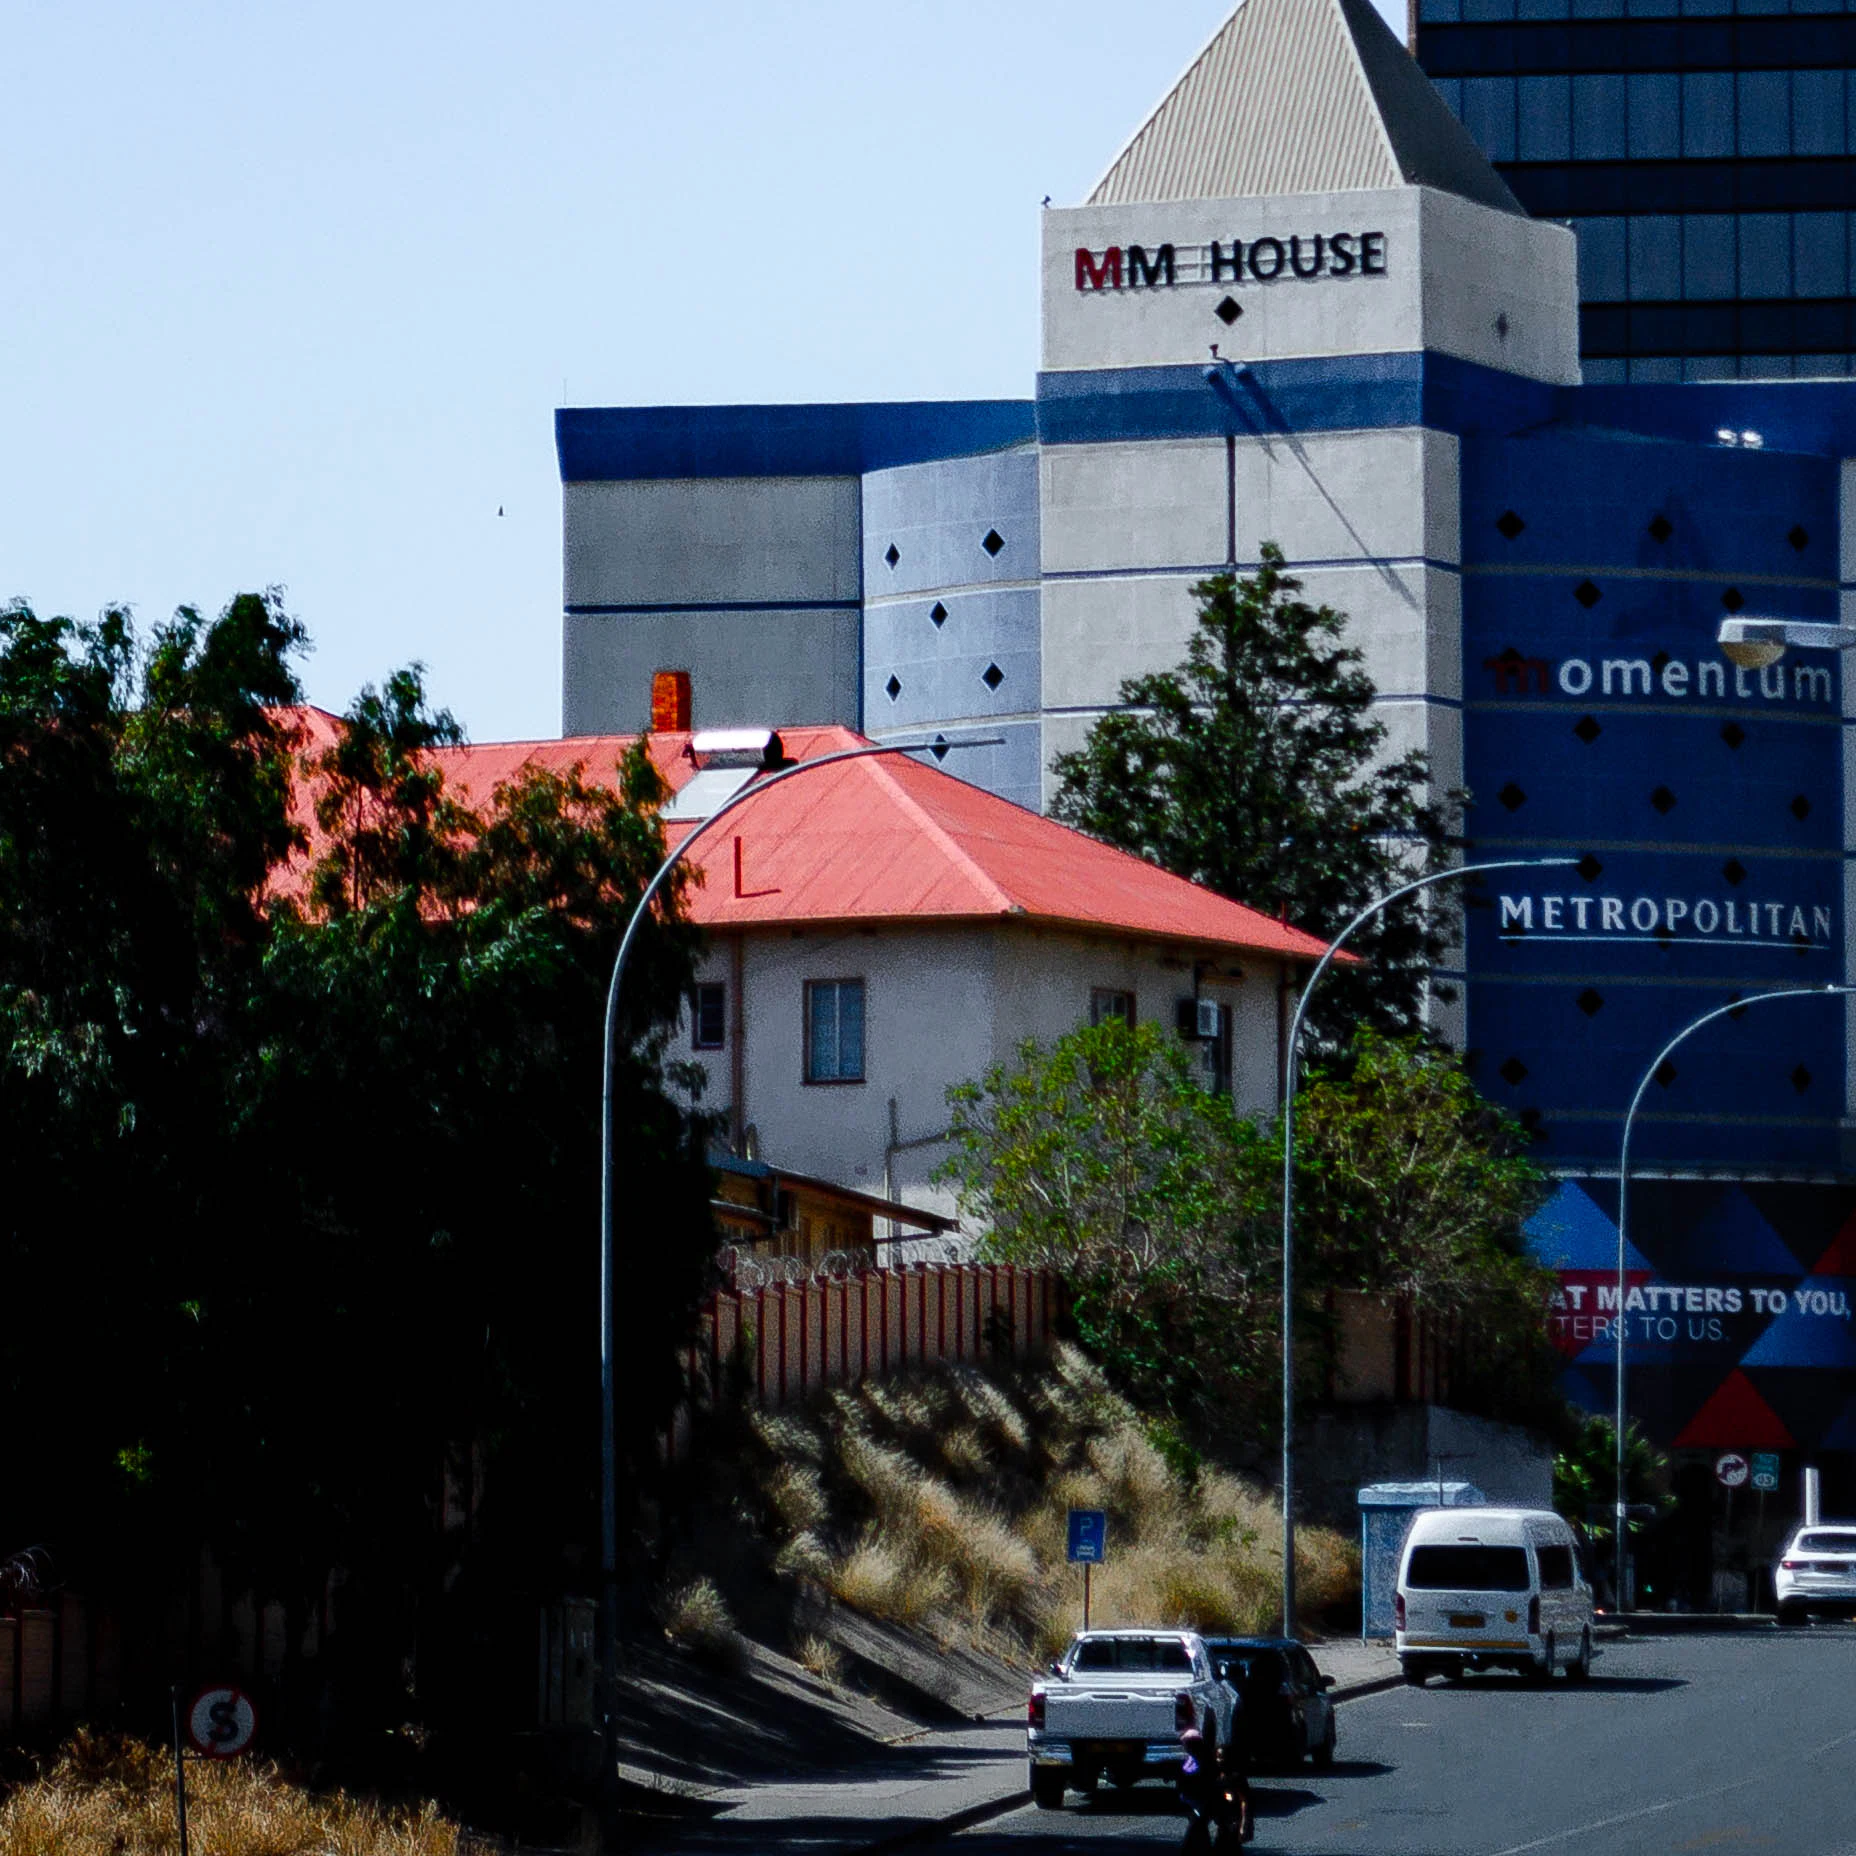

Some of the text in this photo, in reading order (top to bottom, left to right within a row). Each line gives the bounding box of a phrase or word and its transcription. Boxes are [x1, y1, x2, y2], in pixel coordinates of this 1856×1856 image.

[1075, 230, 1385, 291] MM HOUSE
[1498, 895, 1833, 940] METROPOLITAN
[1597, 1285, 1743, 1313] MATTERS
[1749, 1288, 1787, 1315] TO
[1793, 1289, 1851, 1321] YOU,
[1543, 1315, 1630, 1341] TERS
[1639, 1316, 1678, 1341] TO
[1079, 1516, 1094, 1537] P
[207, 1702, 239, 1742] S
